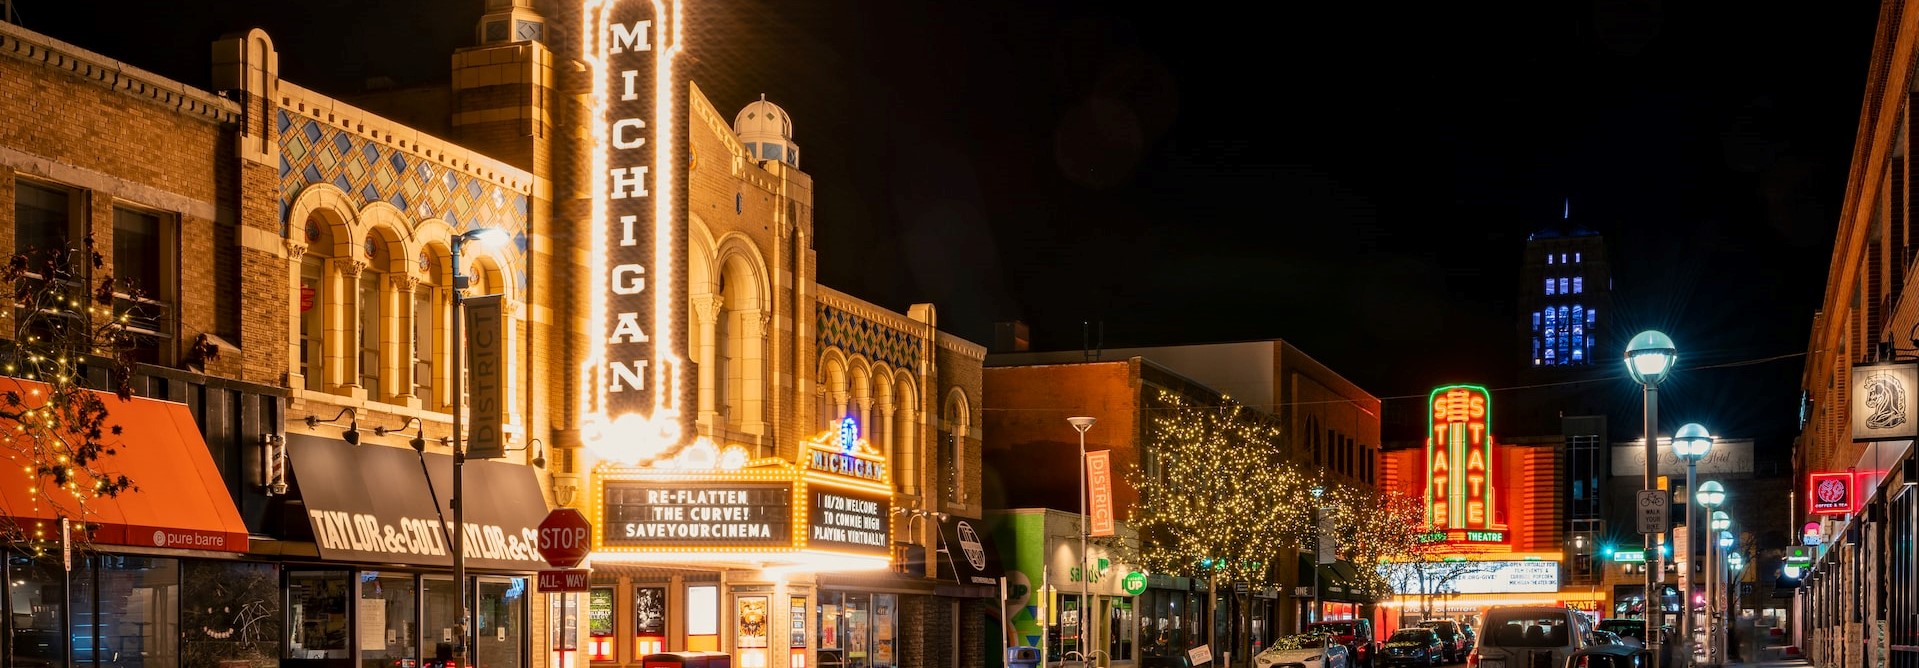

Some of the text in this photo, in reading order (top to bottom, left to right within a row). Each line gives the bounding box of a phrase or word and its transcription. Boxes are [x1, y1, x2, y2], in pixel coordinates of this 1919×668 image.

[609, 19, 652, 393] MICHIGAN
[476, 312, 494, 444] DISTRICT
[812, 451, 882, 480] MICHIGAN
[1434, 397, 1448, 525] STATE
[1468, 396, 1485, 524] STATE
[648, 490, 748, 504] RE-FLATTEN
[1093, 459, 1109, 528] DISTRICT
[824, 494, 877, 515] 11/20 WELCOME
[654, 507, 749, 520] THE CURVE!
[824, 511, 834, 525] TO
[541, 527, 586, 549] STOP
[626, 523, 771, 538] SAVEYOURCINEMA
[814, 526, 846, 542] PLAYING
[1467, 532, 1502, 541] THEATRE
[167, 532, 224, 546] pure barre
[1127, 581, 1143, 591] UP
[1567, 601, 1597, 610] STATE
